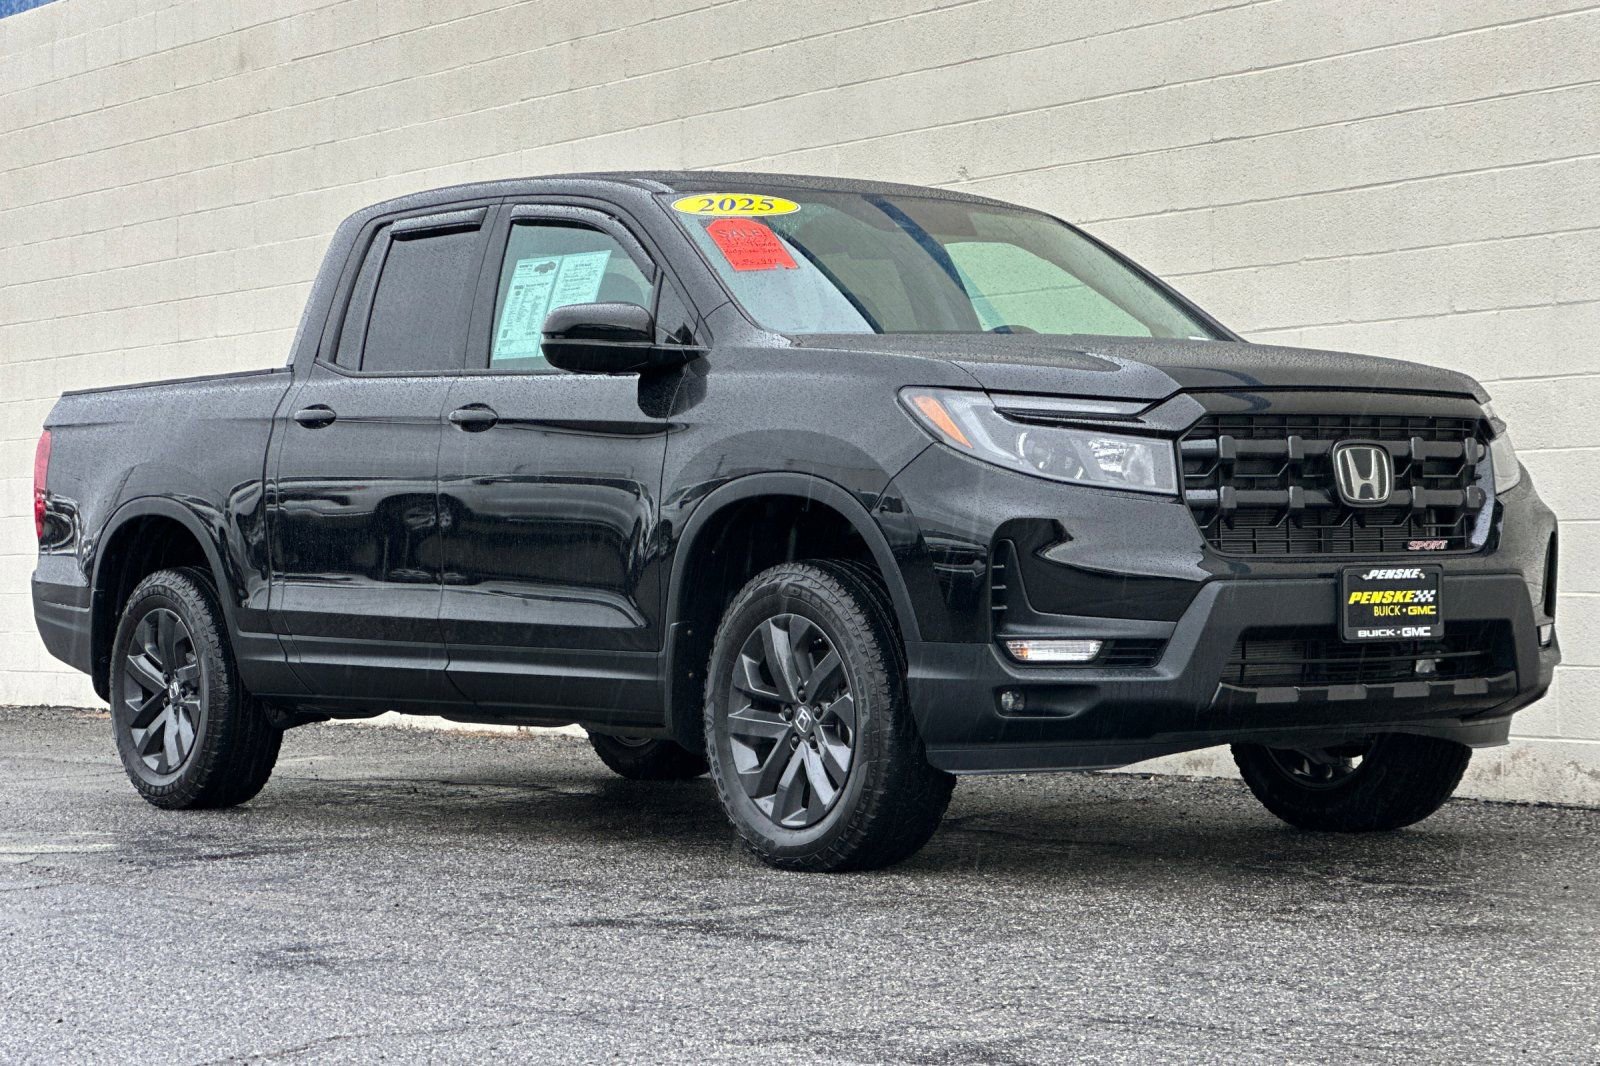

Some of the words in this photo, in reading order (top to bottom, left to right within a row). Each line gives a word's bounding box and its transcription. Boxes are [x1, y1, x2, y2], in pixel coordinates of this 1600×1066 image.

[698, 197, 775, 212] 2025
[1407, 540, 1448, 550] SPORT
[1367, 568, 1421, 580] PENSKE
[1348, 590, 1416, 604] PENSKE
[1373, 605, 1401, 616] BUICK
[1407, 606, 1436, 614] GMC
[1357, 629, 1395, 637] BUICK
[1402, 627, 1431, 637] GMC
